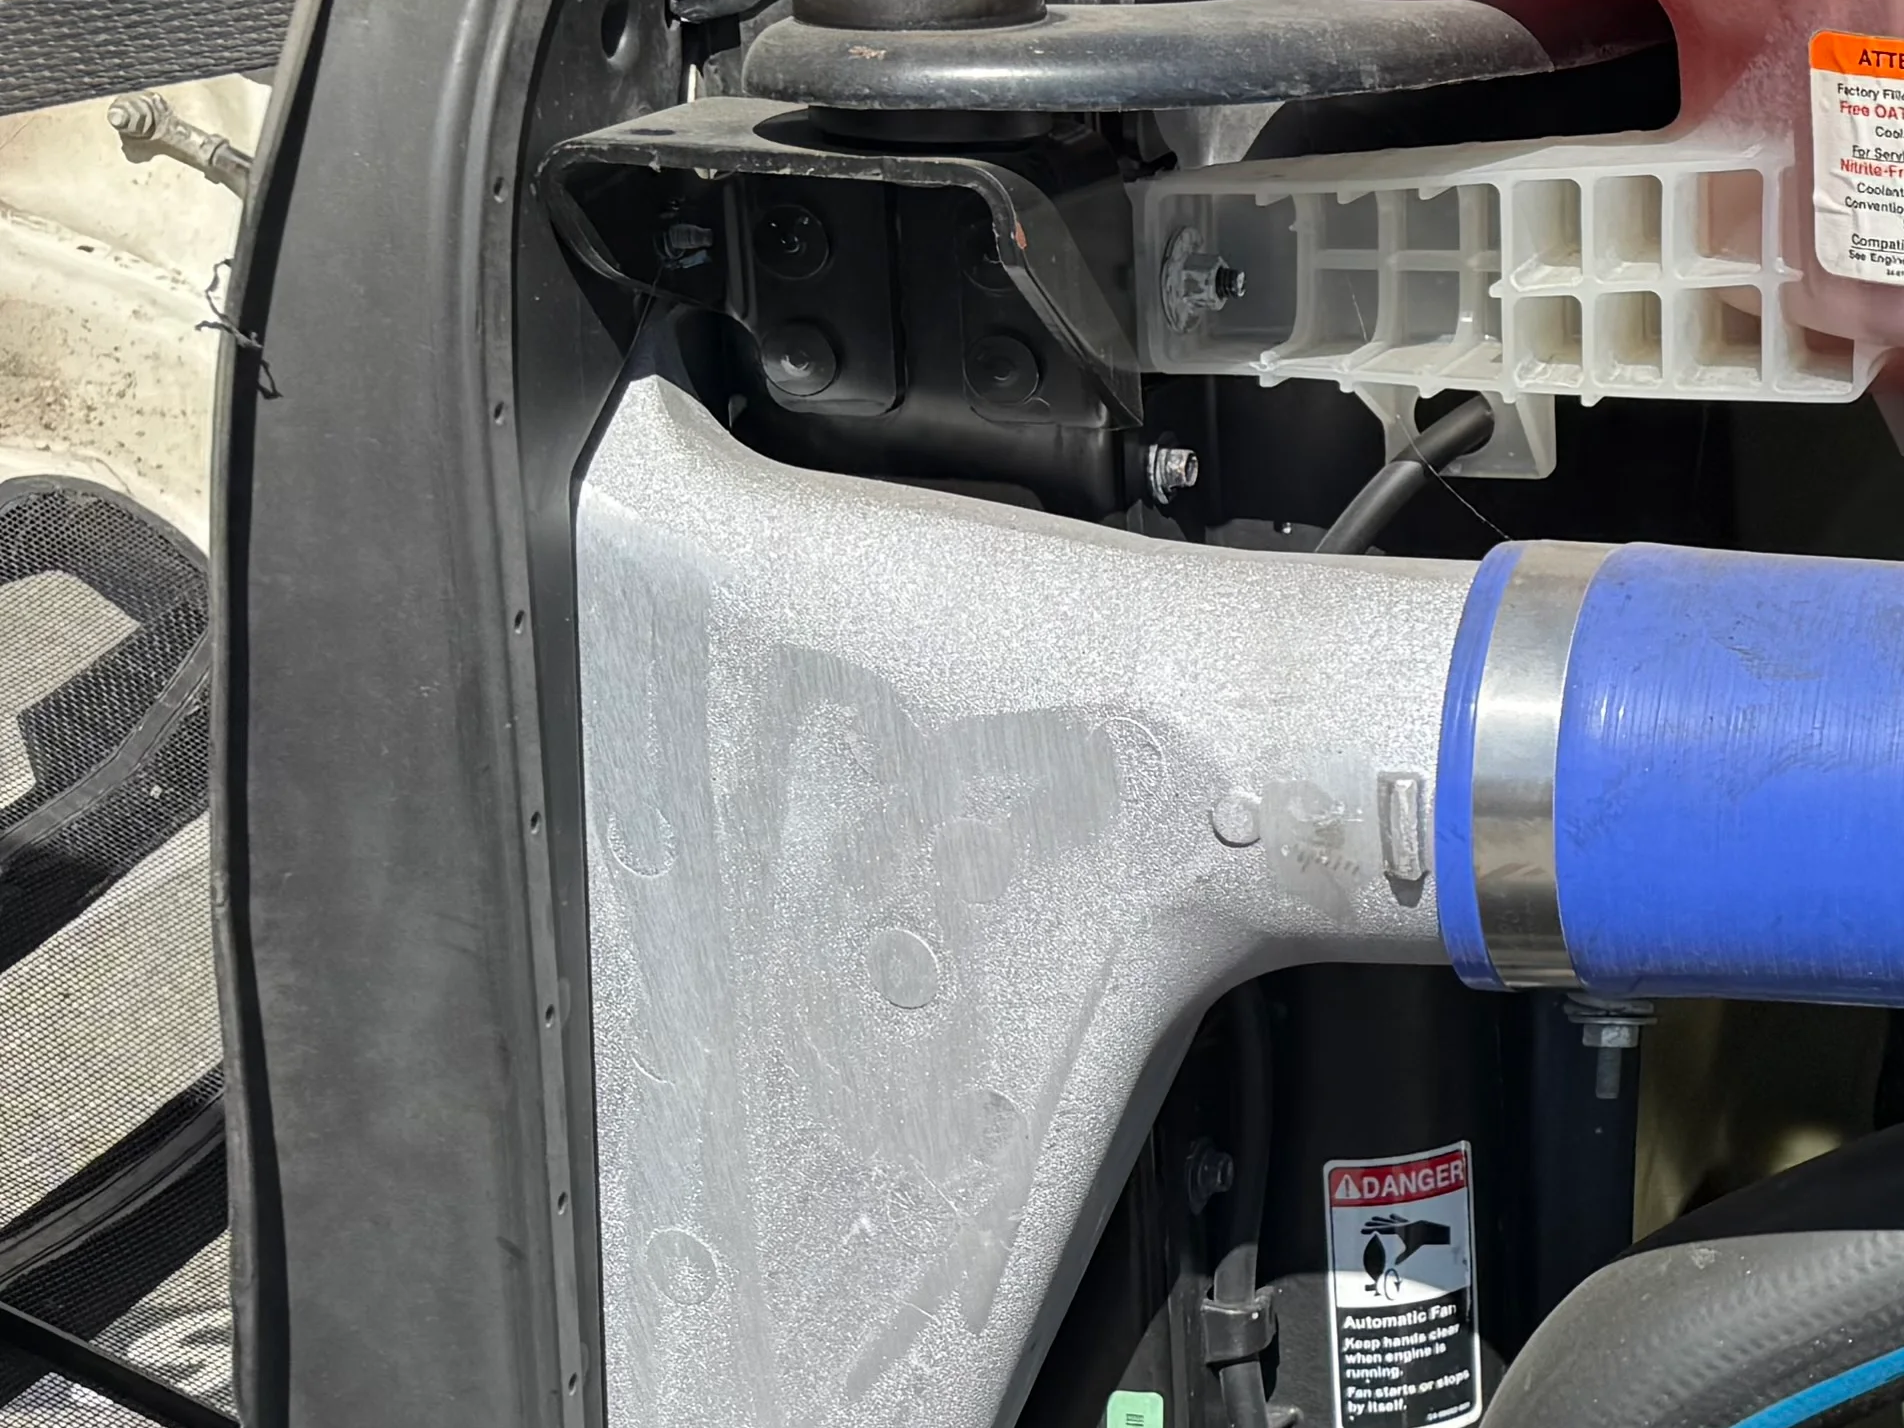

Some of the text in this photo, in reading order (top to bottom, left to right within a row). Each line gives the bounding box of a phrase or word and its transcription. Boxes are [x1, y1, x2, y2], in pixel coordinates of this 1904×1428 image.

[1837, 83, 1880, 101] Factory
[1840, 101, 1870, 117] Free
[1852, 145, 1870, 158] For
[1849, 250, 1867, 262] See
[1362, 1160, 1464, 1199] DANGER
[1344, 1304, 1457, 1330] Automatic Fan
[1343, 1324, 1460, 1352] Keep hands clear
[1344, 1343, 1446, 1364] when engine is
[1346, 1365, 1404, 1380] running.
[1348, 1369, 1470, 1398] Fan starts or stops
[1348, 1397, 1407, 1415] by itself.
